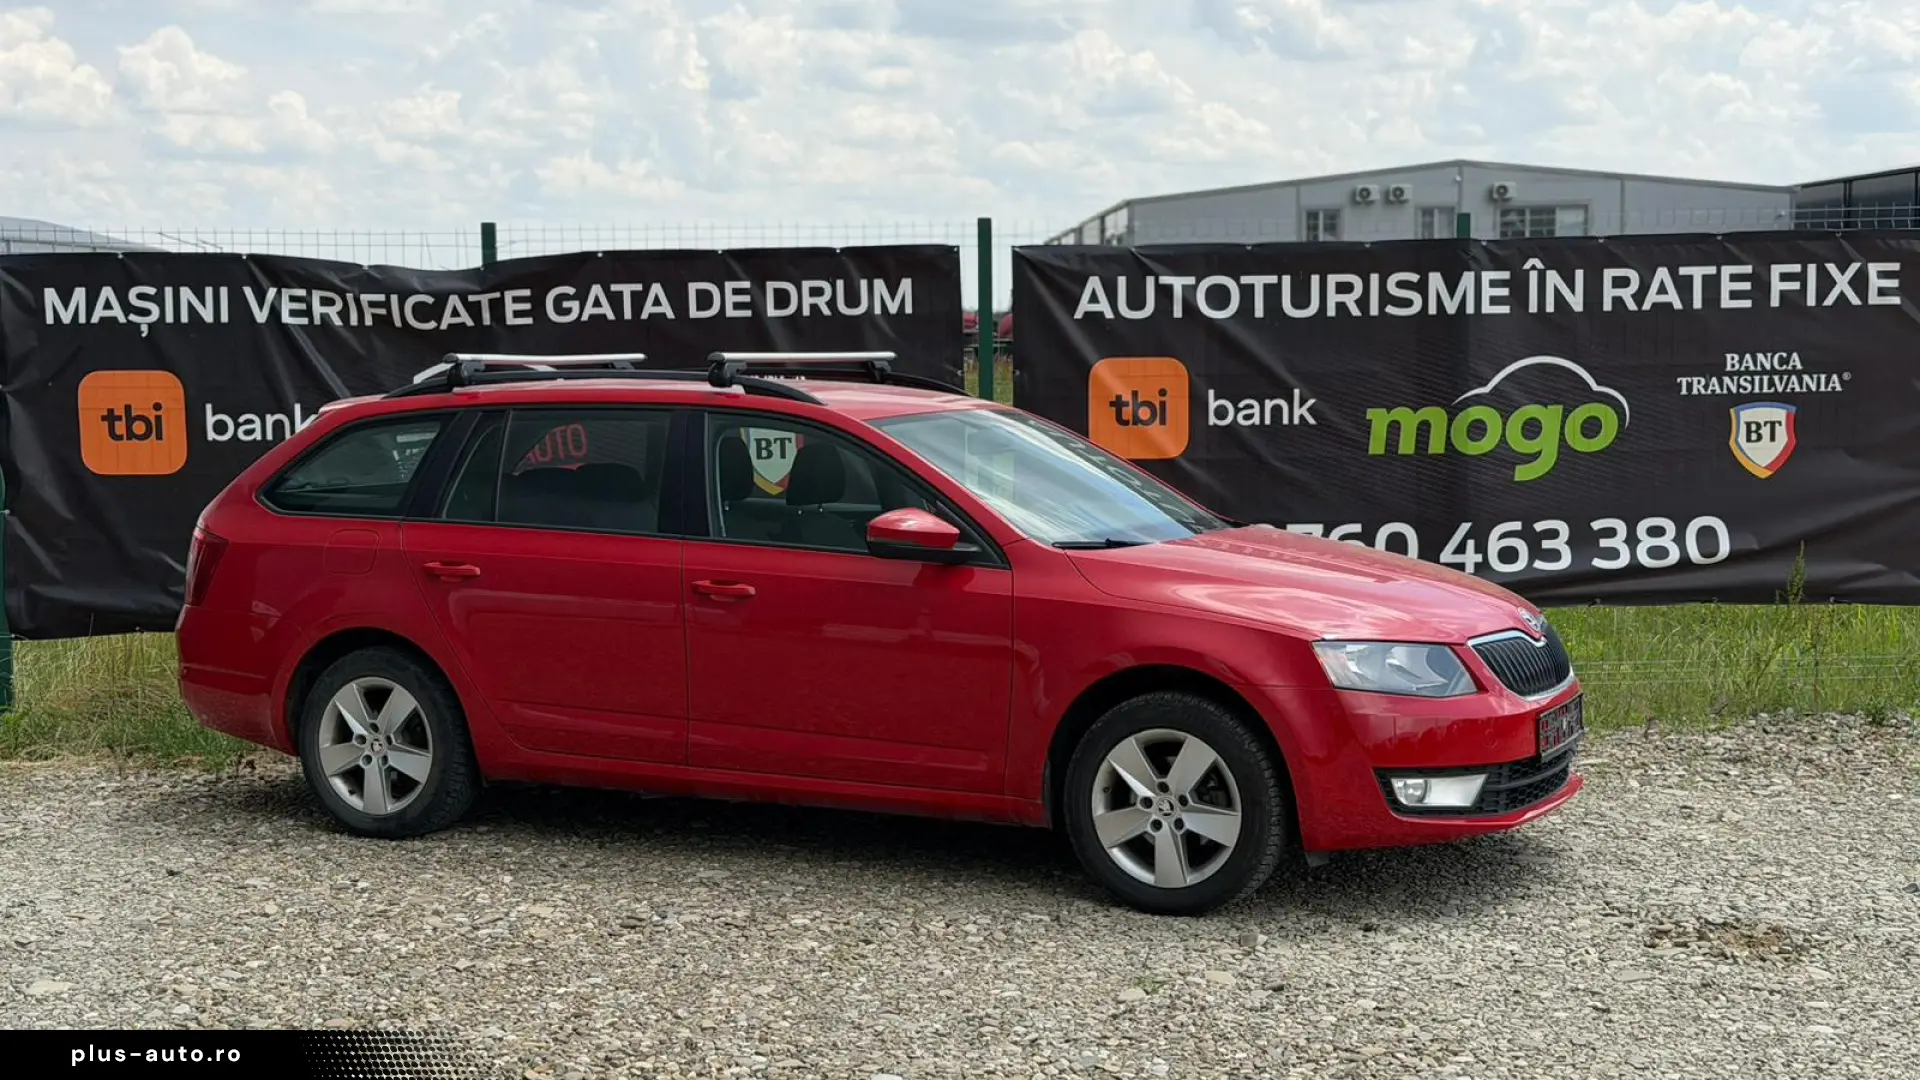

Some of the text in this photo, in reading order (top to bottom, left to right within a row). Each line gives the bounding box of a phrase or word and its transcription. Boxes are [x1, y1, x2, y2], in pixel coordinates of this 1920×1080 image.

[43, 277, 913, 338] MAȘINI VERIFICATE GATA DE DRUM
[1073, 257, 1902, 320] AUTOTURISME ÎN RATE FIXE
[1724, 352, 1804, 372] BANCA
[100, 401, 319, 442] tbi bank
[1108, 387, 1317, 427] tbi bank
[753, 437, 793, 461] BT
[1366, 405, 1620, 482] mogo
[1743, 420, 1783, 444] BT
[1439, 519, 1573, 575] 463
[1589, 515, 1732, 571] 380
